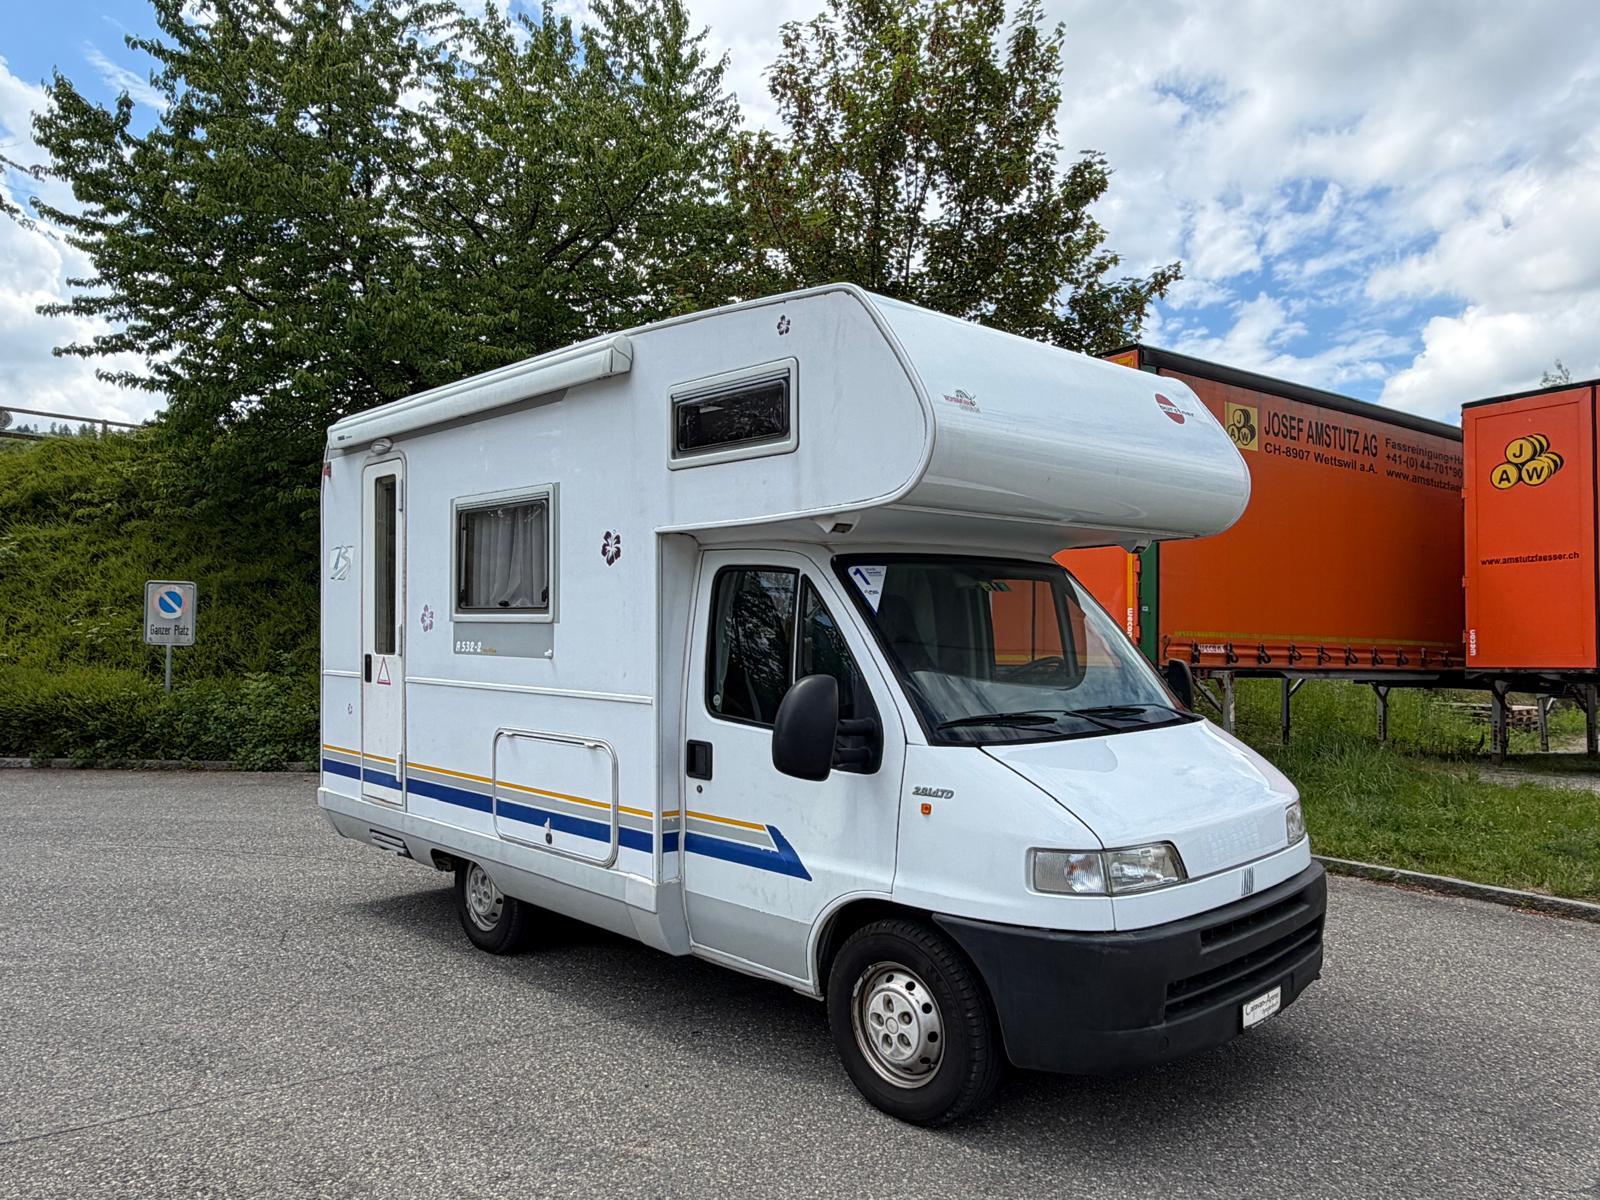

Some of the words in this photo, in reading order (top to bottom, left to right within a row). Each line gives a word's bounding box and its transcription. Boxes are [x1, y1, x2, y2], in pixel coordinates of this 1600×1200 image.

[1264, 411, 1304, 441] JOSEF
[1306, 420, 1360, 454] AMSTUTZ
[1362, 433, 1378, 457] AG
[1264, 442, 1311, 460] CH-8907
[1314, 452, 1357, 469] Wettswil
[1360, 463, 1378, 473] a.A.
[1512, 443, 1524, 458] J
[1498, 469, 1511, 484] A
[1525, 466, 1544, 481] W
[1481, 551, 1580, 565] www.amstutzfaesser.ch
[150, 624, 171, 635] Ganzer
[174, 625, 189, 635] Platz
